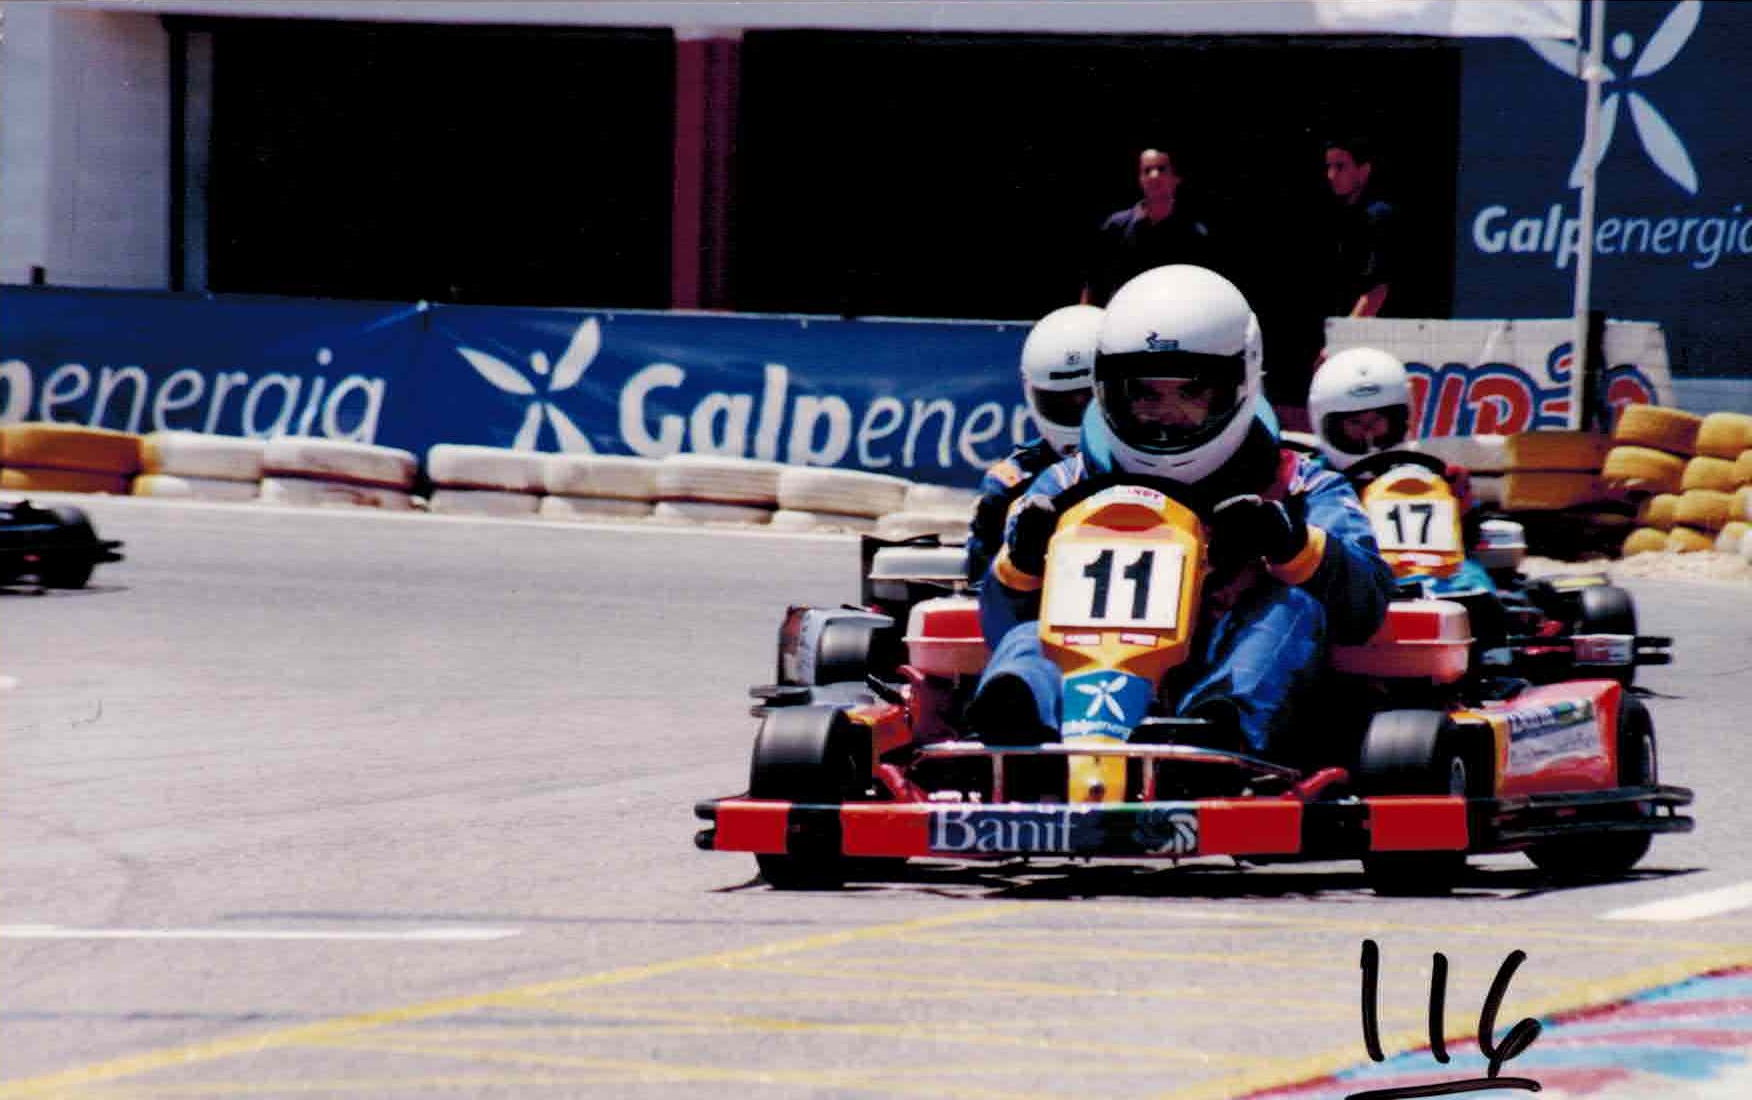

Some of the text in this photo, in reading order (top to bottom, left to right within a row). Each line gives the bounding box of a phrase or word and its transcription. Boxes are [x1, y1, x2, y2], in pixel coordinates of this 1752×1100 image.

[1387, 504, 1436, 545] 17
[1083, 549, 1155, 620] 11
[930, 806, 1076, 852] Banif
